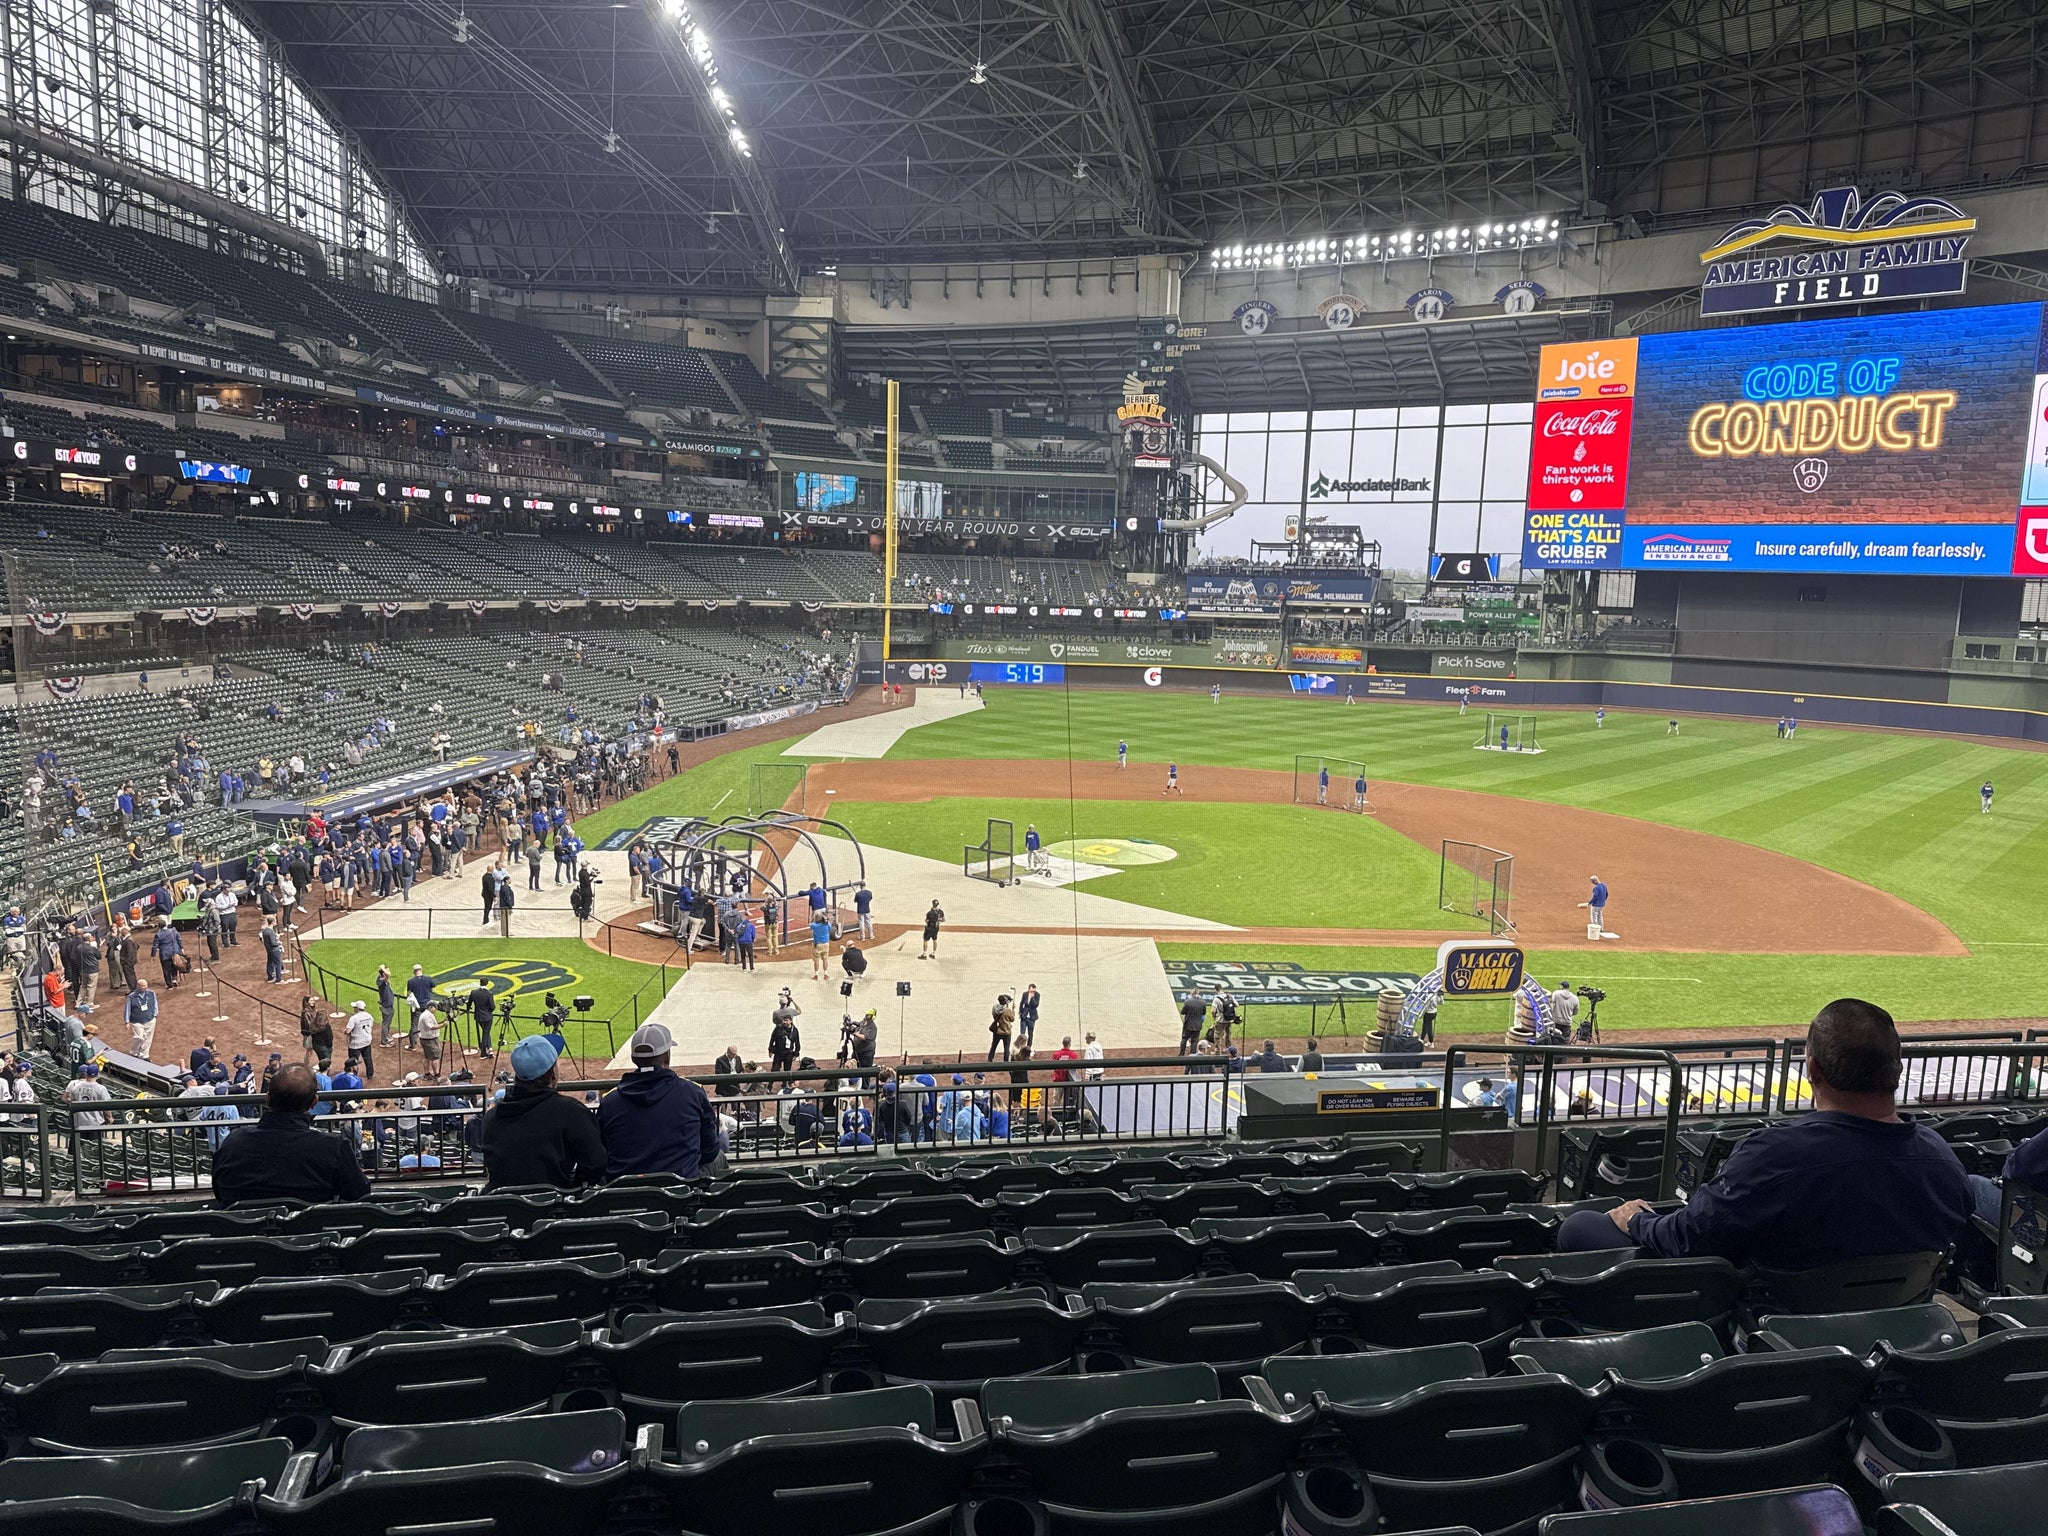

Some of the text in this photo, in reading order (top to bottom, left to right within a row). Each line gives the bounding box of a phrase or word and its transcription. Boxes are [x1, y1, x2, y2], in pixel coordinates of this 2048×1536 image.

[1704, 236, 1971, 287] AMERICAN FAMILY
[1509, 281, 1532, 290] SELIG
[1774, 273, 1880, 304] FIELD
[1418, 290, 1443, 298] AARON
[1241, 301, 1271, 312] FINGERS
[1323, 296, 1358, 308] ROBINSON
[1516, 295, 1524, 312] 1
[1329, 308, 1350, 325] 42
[1418, 302, 1439, 319] 44
[1244, 312, 1264, 330] 34
[1177, 328, 1207, 337] GONE!
[149, 346, 166, 358] REPORT
[168, 349, 178, 361] FAN
[210, 358, 220, 370] TEXT
[1555, 351, 1615, 381] Joie
[1746, 358, 1899, 399] CODE OF
[1126, 394, 1159, 404] BERNIE'S
[1543, 388, 1579, 398] joiebaby.com
[383, 394, 476, 418] Northwestern Mutual LEGENDS CLUB
[1117, 403, 1166, 420] CHALET
[503, 418, 542, 430] Northwestern
[544, 423, 564, 432] Mutual
[570, 427, 592, 437] LEGENDS
[1544, 409, 1623, 438] Coca-Cola
[1690, 393, 1954, 455] CONDUCT
[14, 442, 27, 459] G
[666, 440, 714, 452] CASAMIGOS
[125, 455, 136, 471] G
[1546, 464, 1612, 474] Fan work is
[299, 474, 308, 488] G
[1542, 474, 1614, 485] thirsty work
[808, 516, 848, 526] GOLF
[917, 520, 954, 532] YEAR
[963, 522, 1018, 534] ROUND
[1070, 528, 1110, 536] GOLF
[1126, 518, 1137, 532] G
[1530, 514, 1620, 528] ONE CALL...
[1528, 530, 1620, 544] THAT'S ALL!
[1537, 544, 1607, 558] GRUBER
[1644, 545, 1729, 553] AMERICAN FAMILY
[1755, 540, 1986, 561] Insure carefully, dream fearlessly.
[1457, 560, 1471, 574] G
[1287, 584, 1322, 598] Miller
[964, 604, 973, 614] G
[1029, 606, 1038, 616] G
[1094, 608, 1102, 618] G
[967, 644, 993, 654] Tito's
[1138, 646, 1172, 656] clover
[1222, 640, 1268, 652] Johnsonville
[1296, 649, 1336, 661] Surfside
[1475, 658, 1505, 668] Save
[1006, 664, 1043, 682] 5:19
[1144, 667, 1162, 686] G
[1446, 686, 1506, 696] Fleet Farm
[1456, 952, 1518, 968] MAGIC
[1468, 968, 1514, 990] BREW
